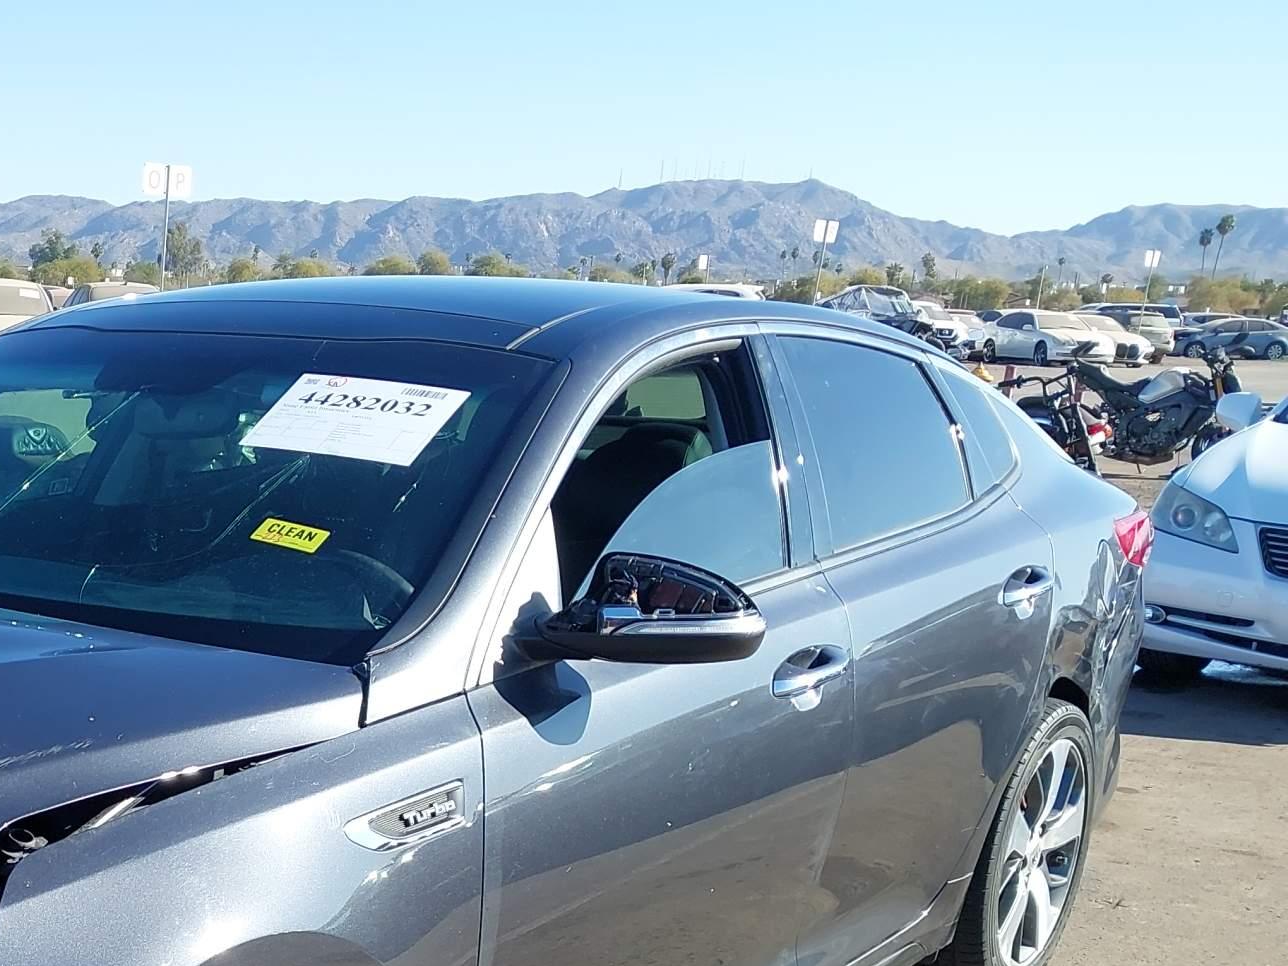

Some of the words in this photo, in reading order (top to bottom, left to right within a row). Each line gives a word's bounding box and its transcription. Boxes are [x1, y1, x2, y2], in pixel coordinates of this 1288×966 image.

[298, 390, 433, 418] 44282032
[267, 523, 318, 542] CLEAN
[400, 799, 457, 827] Turbo
